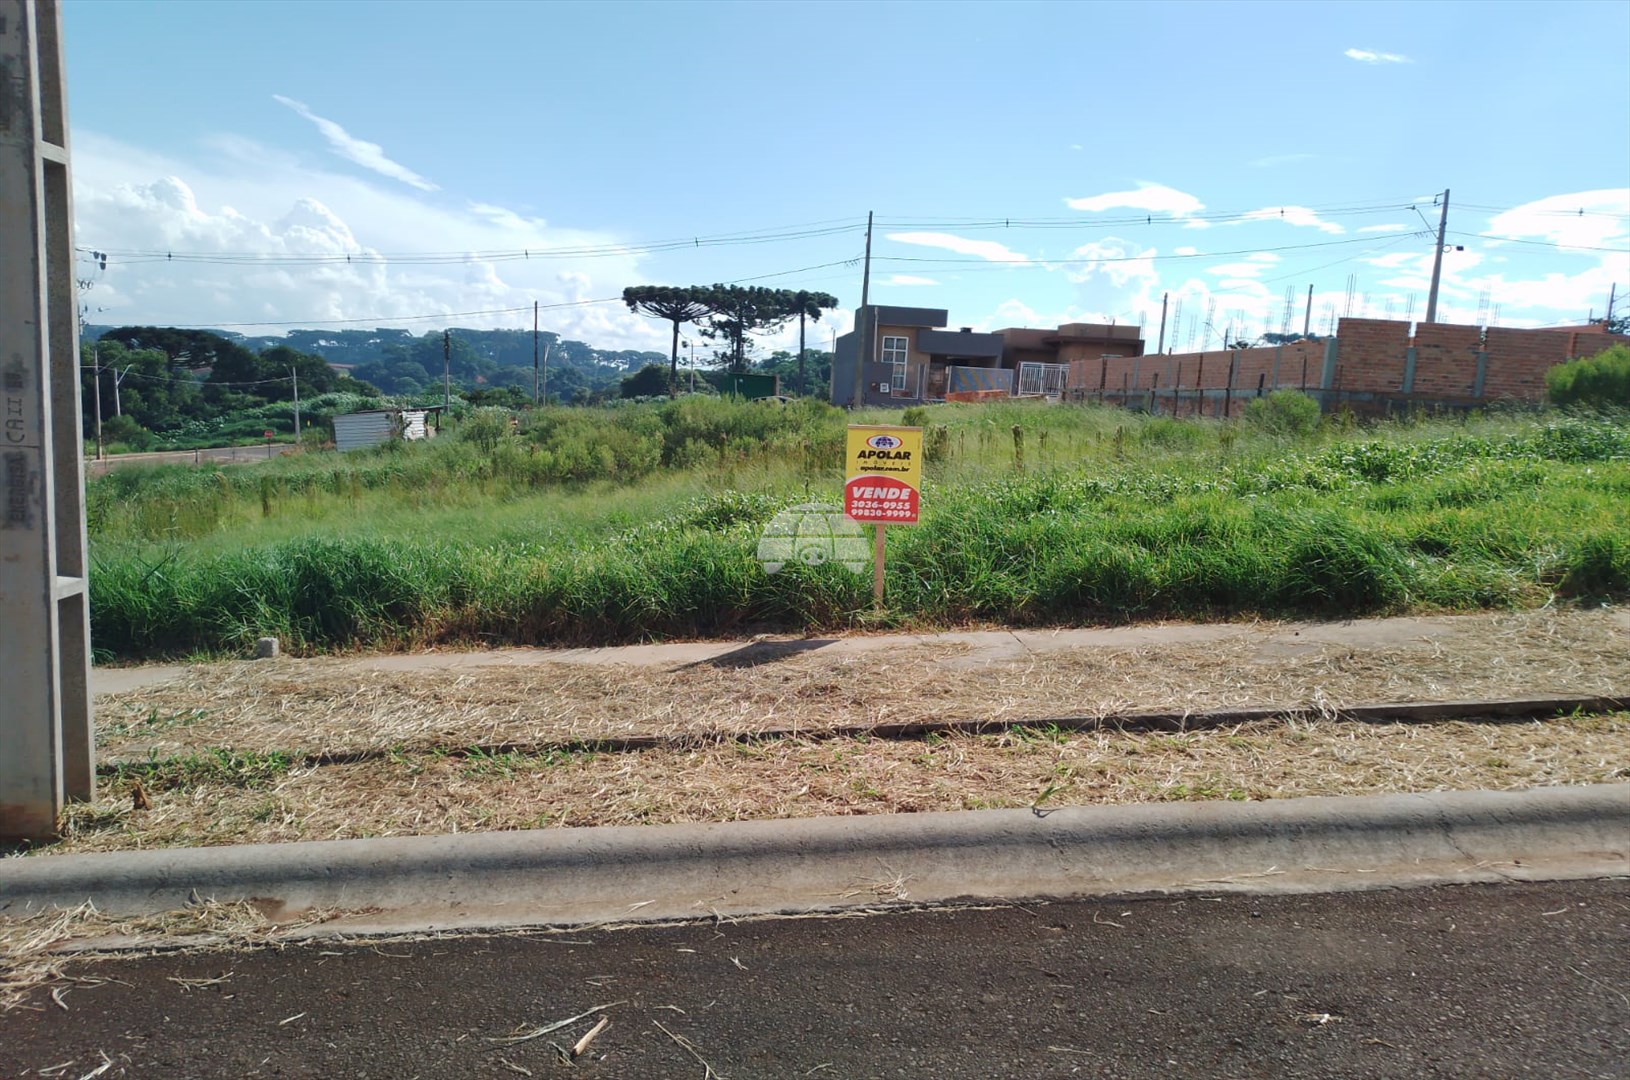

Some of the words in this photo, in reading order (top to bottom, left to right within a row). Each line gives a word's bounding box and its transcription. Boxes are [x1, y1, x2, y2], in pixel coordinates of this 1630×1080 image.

[857, 450, 911, 460] APOLAR
[852, 486, 911, 500] VENDE
[851, 500, 911, 510] 3036-0955
[851, 509, 911, 518] 99830-9999
